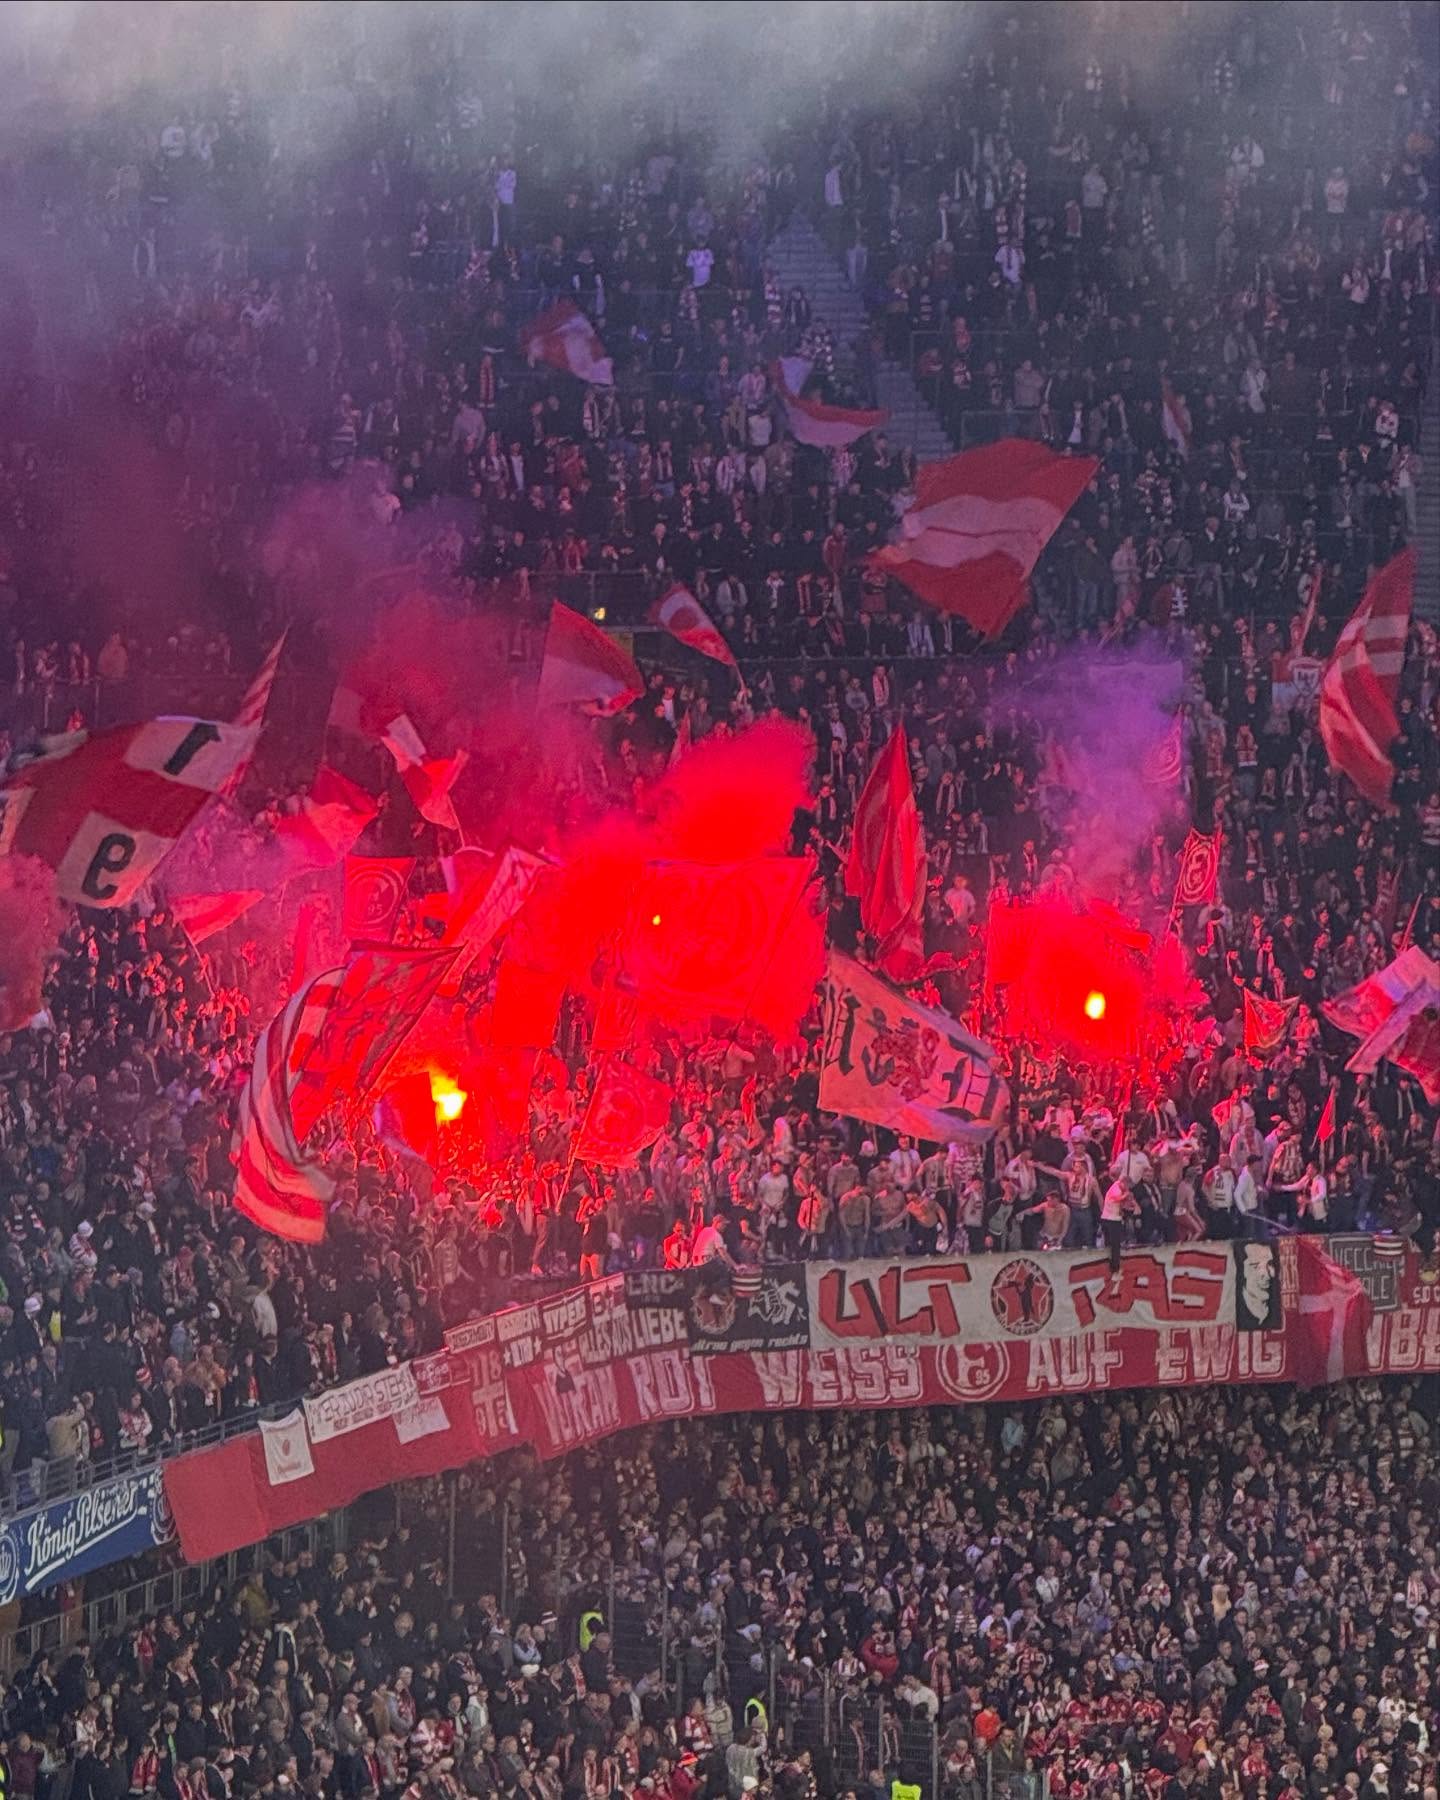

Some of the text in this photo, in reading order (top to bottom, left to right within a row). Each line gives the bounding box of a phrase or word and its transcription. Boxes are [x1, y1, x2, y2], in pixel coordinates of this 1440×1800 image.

[632, 1308, 688, 1349] LIEBE
[819, 1263, 972, 1339] ULT
[1068, 1250, 1228, 1328] RAS
[627, 1348, 714, 1420] ROT
[751, 1344, 923, 1408] WEISS
[1027, 1328, 1122, 1391] AUF
[1155, 1323, 1286, 1383] EWIG
[25, 1481, 138, 1576] König Pilsener
